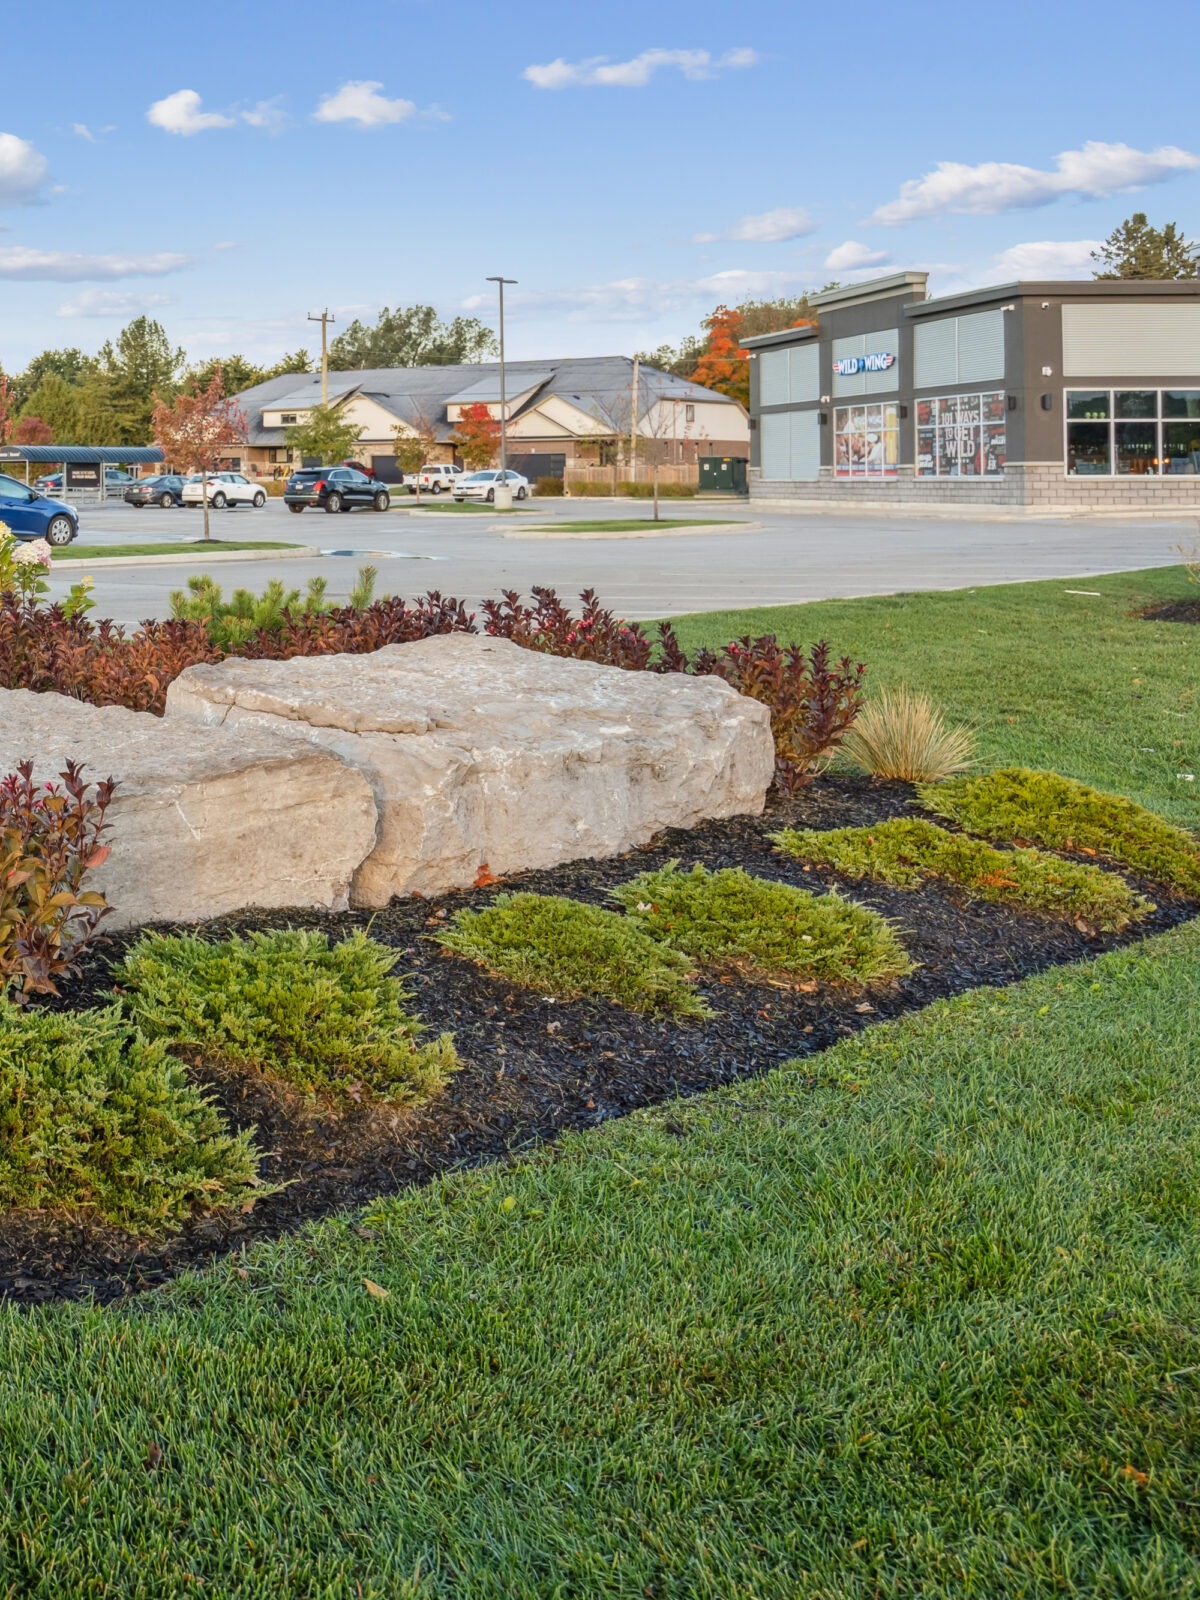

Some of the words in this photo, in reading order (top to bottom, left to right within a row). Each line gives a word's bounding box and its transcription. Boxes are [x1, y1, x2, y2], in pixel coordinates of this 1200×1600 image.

[838, 358, 859, 375] WILD
[864, 353, 888, 371] WING
[941, 412, 953, 426] 101
[955, 410, 980, 425] WAYS
[945, 440, 976, 458] WLD
